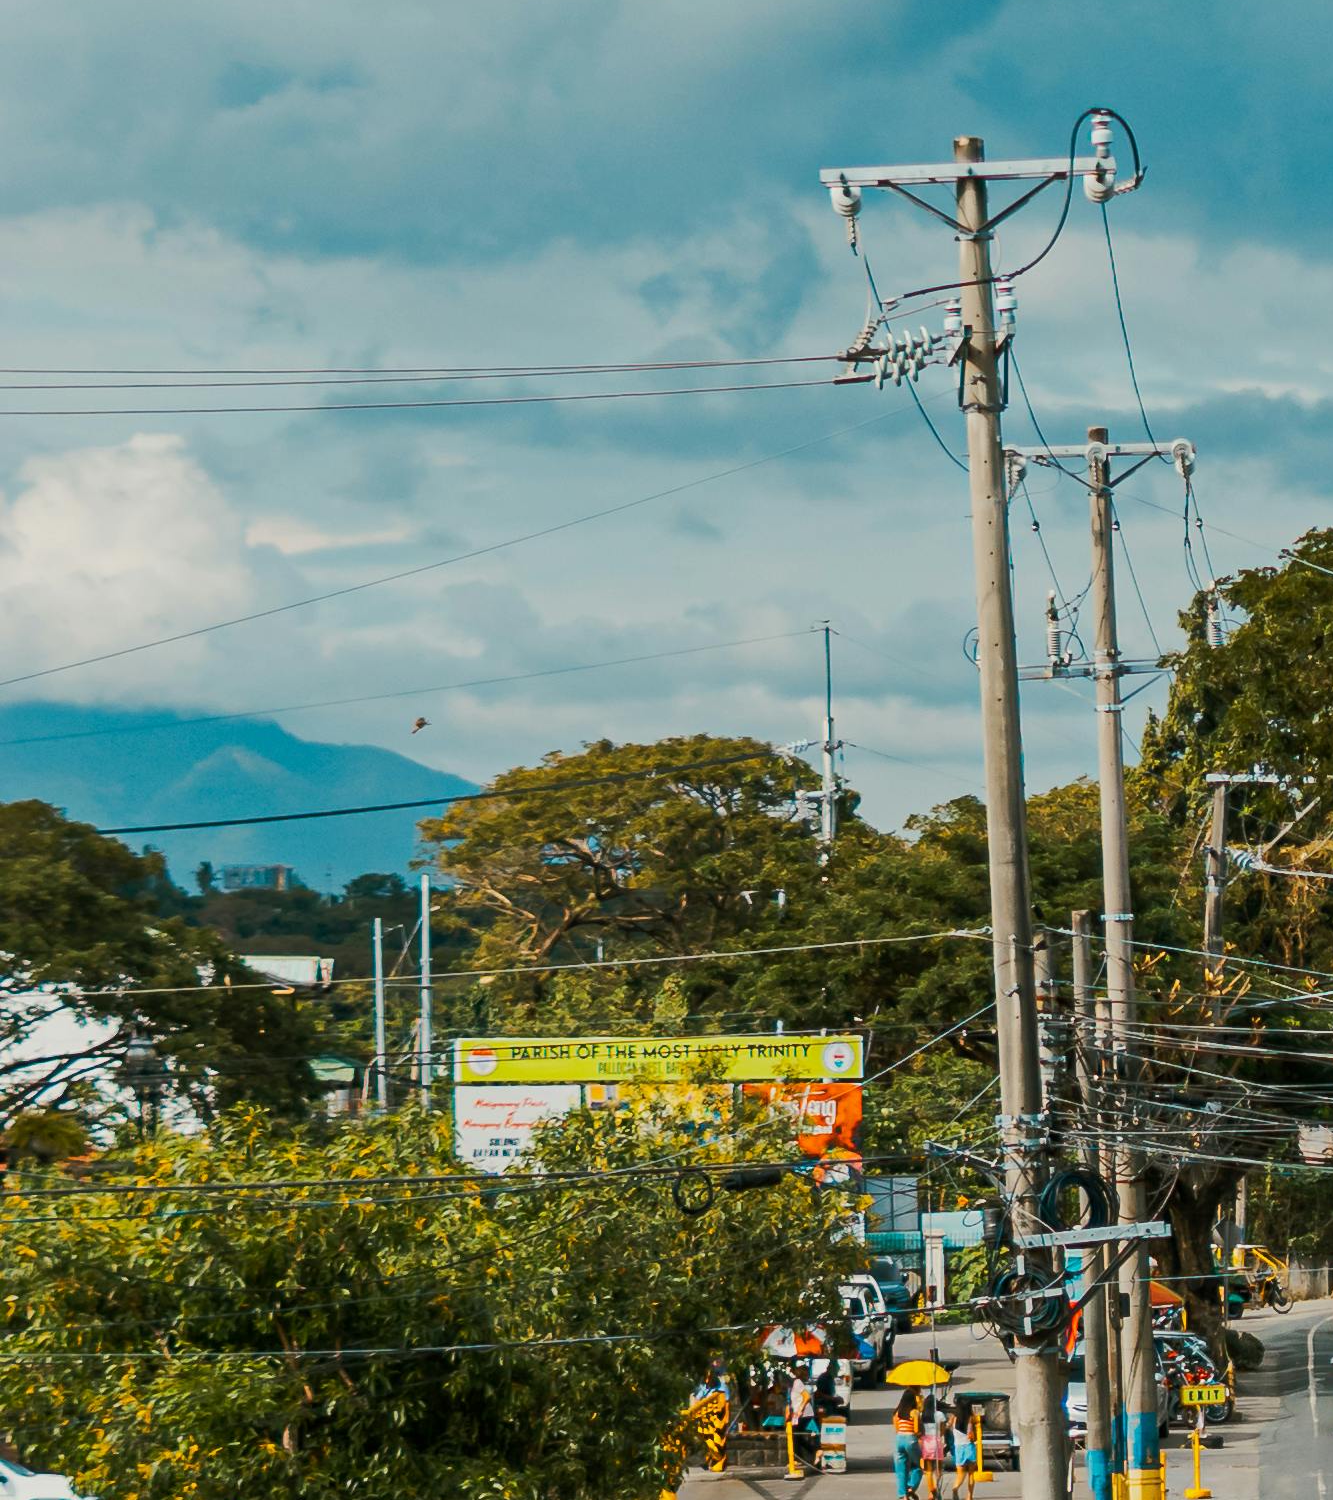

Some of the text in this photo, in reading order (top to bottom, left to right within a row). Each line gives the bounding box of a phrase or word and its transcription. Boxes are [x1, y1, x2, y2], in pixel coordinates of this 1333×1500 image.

[512, 1044, 570, 1060] PARISH
[576, 1043, 600, 1060] OF
[606, 1043, 637, 1060] THE
[643, 1043, 690, 1060] MOST
[748, 1042, 811, 1059] TRINITY
[1189, 1389, 1220, 1402] EXIT
